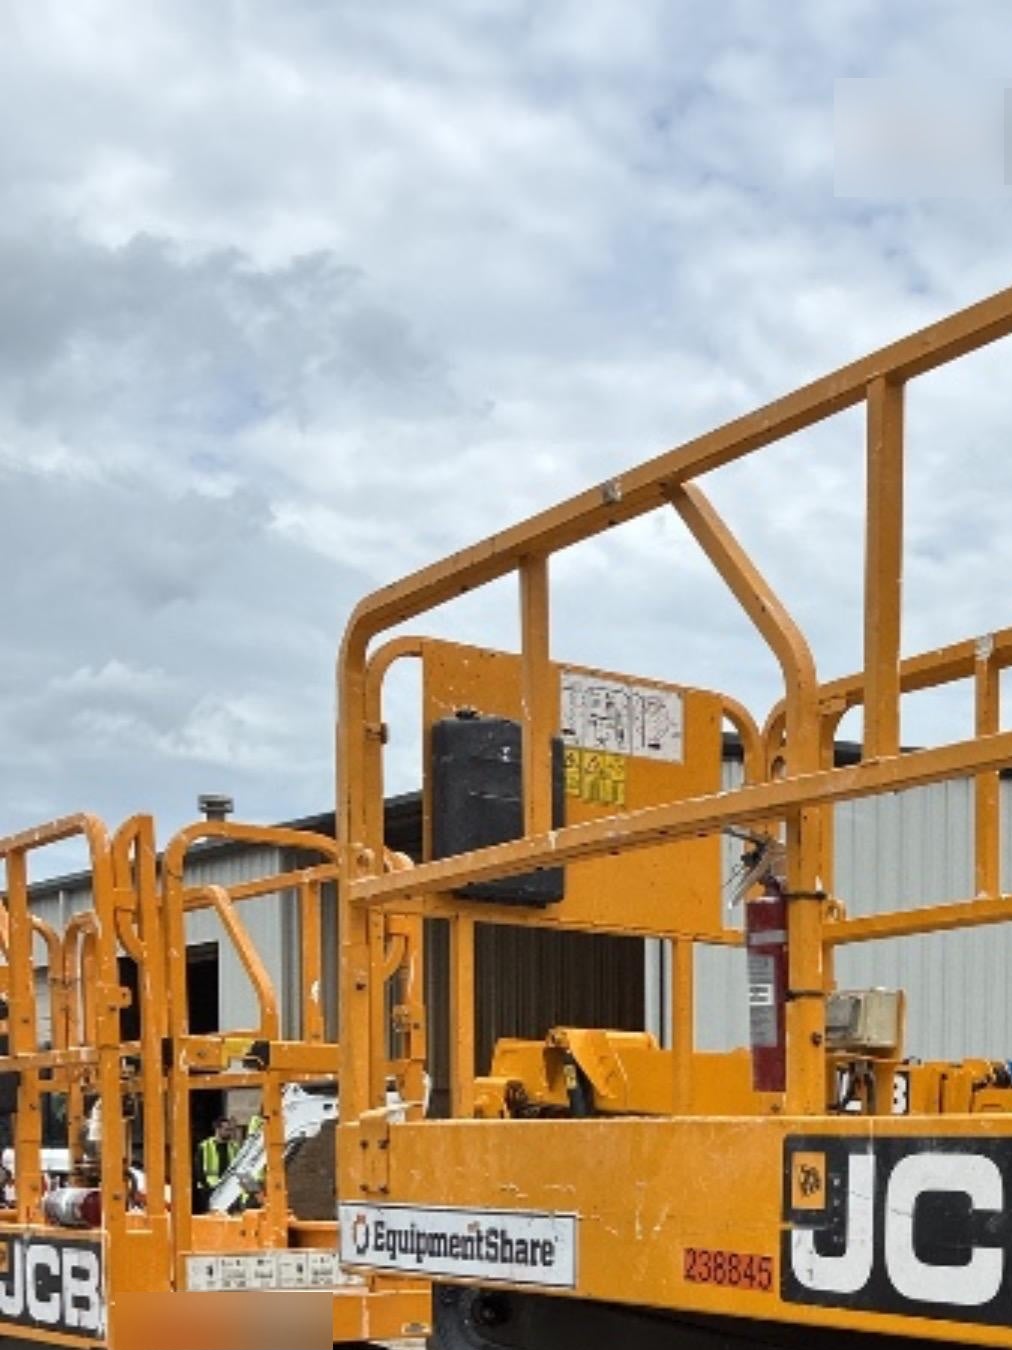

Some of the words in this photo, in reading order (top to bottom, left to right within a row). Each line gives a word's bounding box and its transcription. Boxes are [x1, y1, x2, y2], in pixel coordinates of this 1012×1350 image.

[373, 1219, 556, 1267] EquipmentShare
[0, 1239, 102, 1331] JCB
[684, 1247, 772, 1291] 238845
